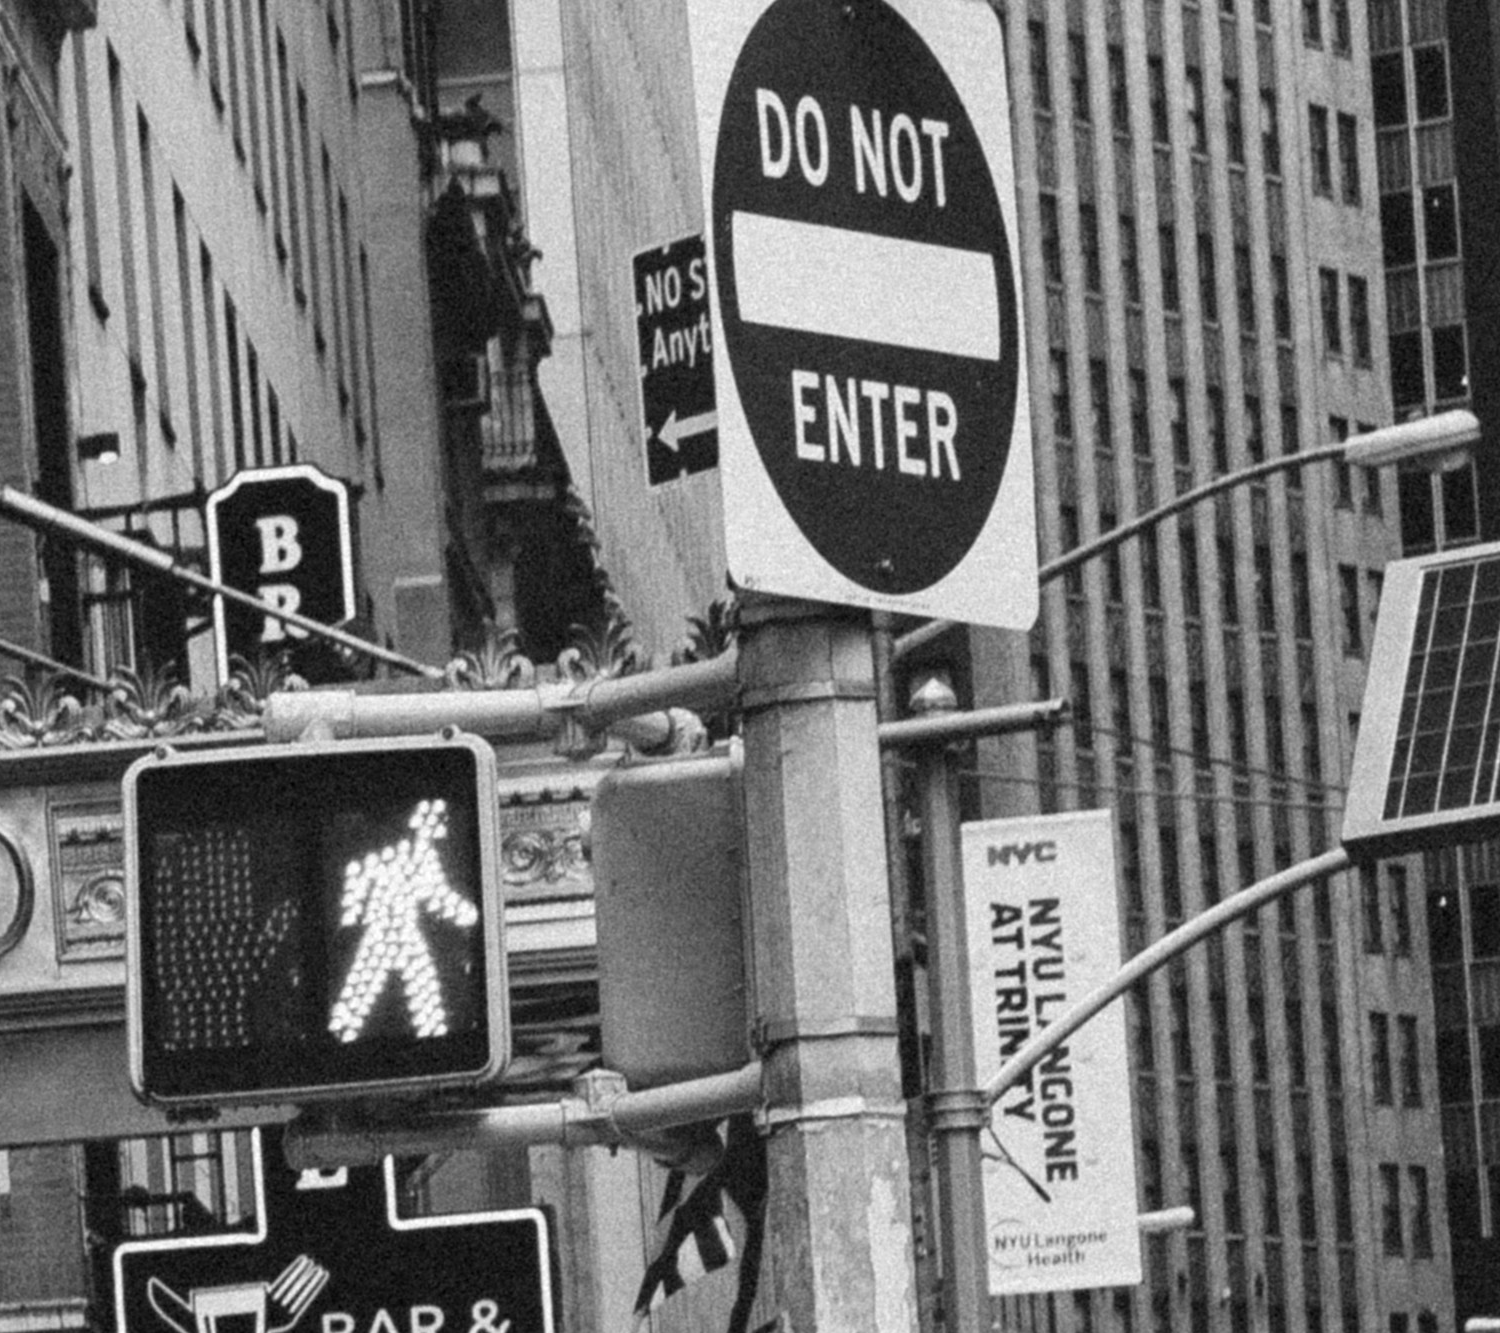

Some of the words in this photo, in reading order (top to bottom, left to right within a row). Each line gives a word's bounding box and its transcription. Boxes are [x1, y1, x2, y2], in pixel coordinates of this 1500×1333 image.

[756, 88, 829, 187] DO
[850, 104, 949, 207] NOT
[646, 270, 681, 315] NO
[792, 369, 960, 481] ENTER
[988, 841, 1057, 866] NYC
[990, 902, 1025, 950] AT
[1028, 898, 1065, 981] NYU
[1035, 993, 1079, 1183] LNGONE
[994, 1233, 1030, 1250] NYU
[1034, 1231, 1107, 1252] Langone
[1027, 1249, 1085, 1267] Health
